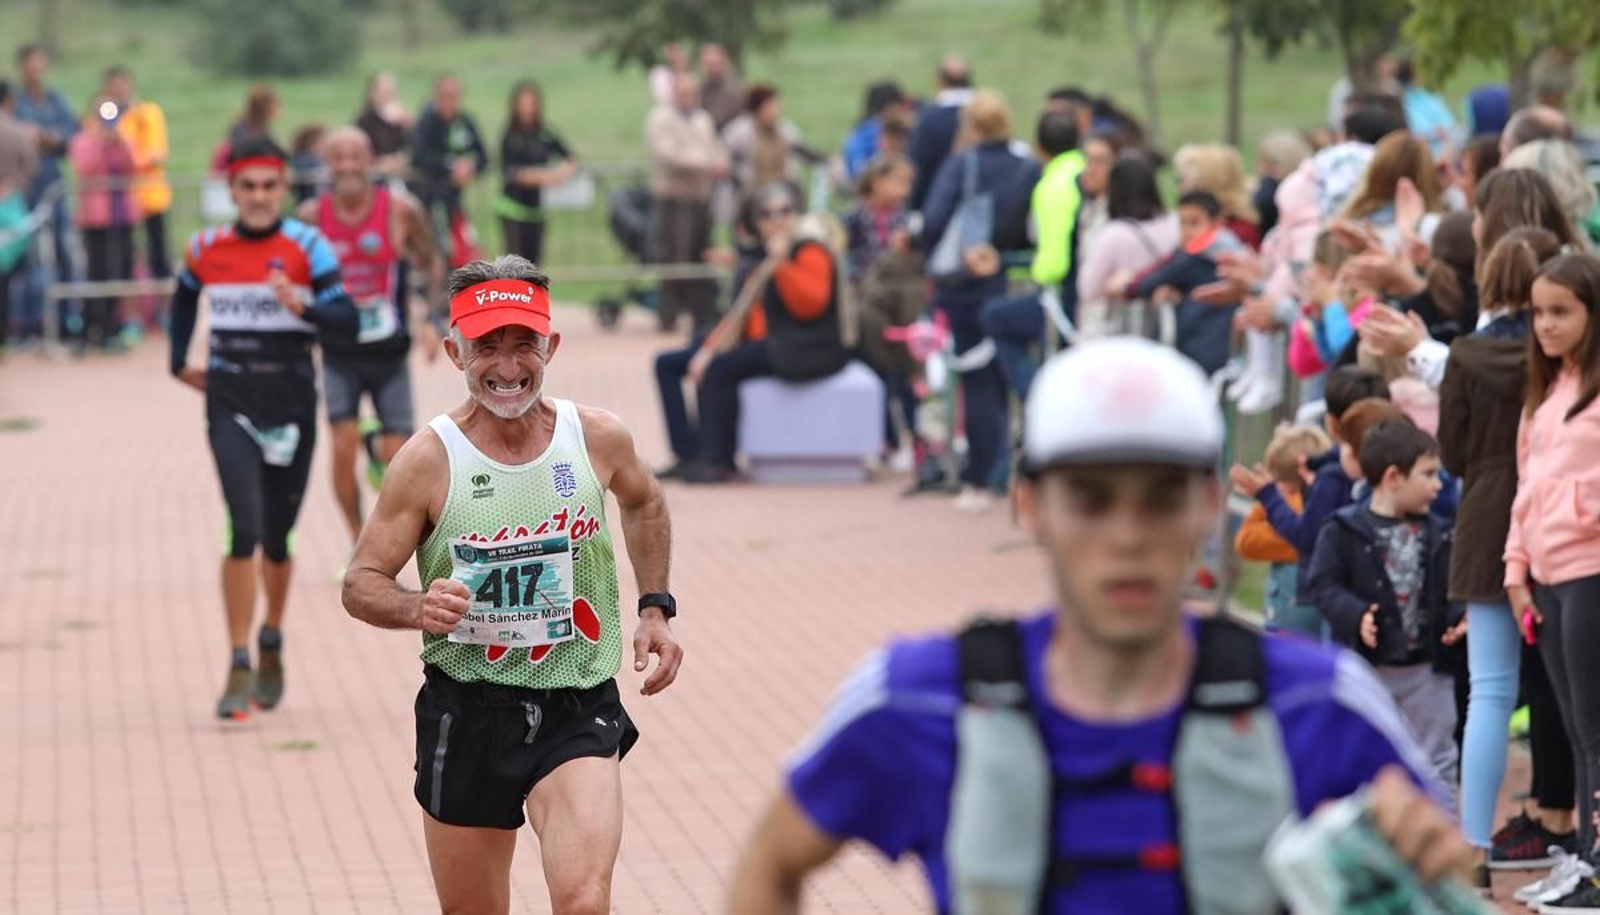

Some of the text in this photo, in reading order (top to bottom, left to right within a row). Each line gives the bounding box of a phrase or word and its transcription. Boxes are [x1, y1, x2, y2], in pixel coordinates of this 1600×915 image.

[476, 290, 532, 306] V-Power
[499, 546, 517, 556] TRAIL
[518, 543, 543, 552] PIRATA
[476, 563, 544, 608] 417
[488, 612, 538, 623] Sánchez
